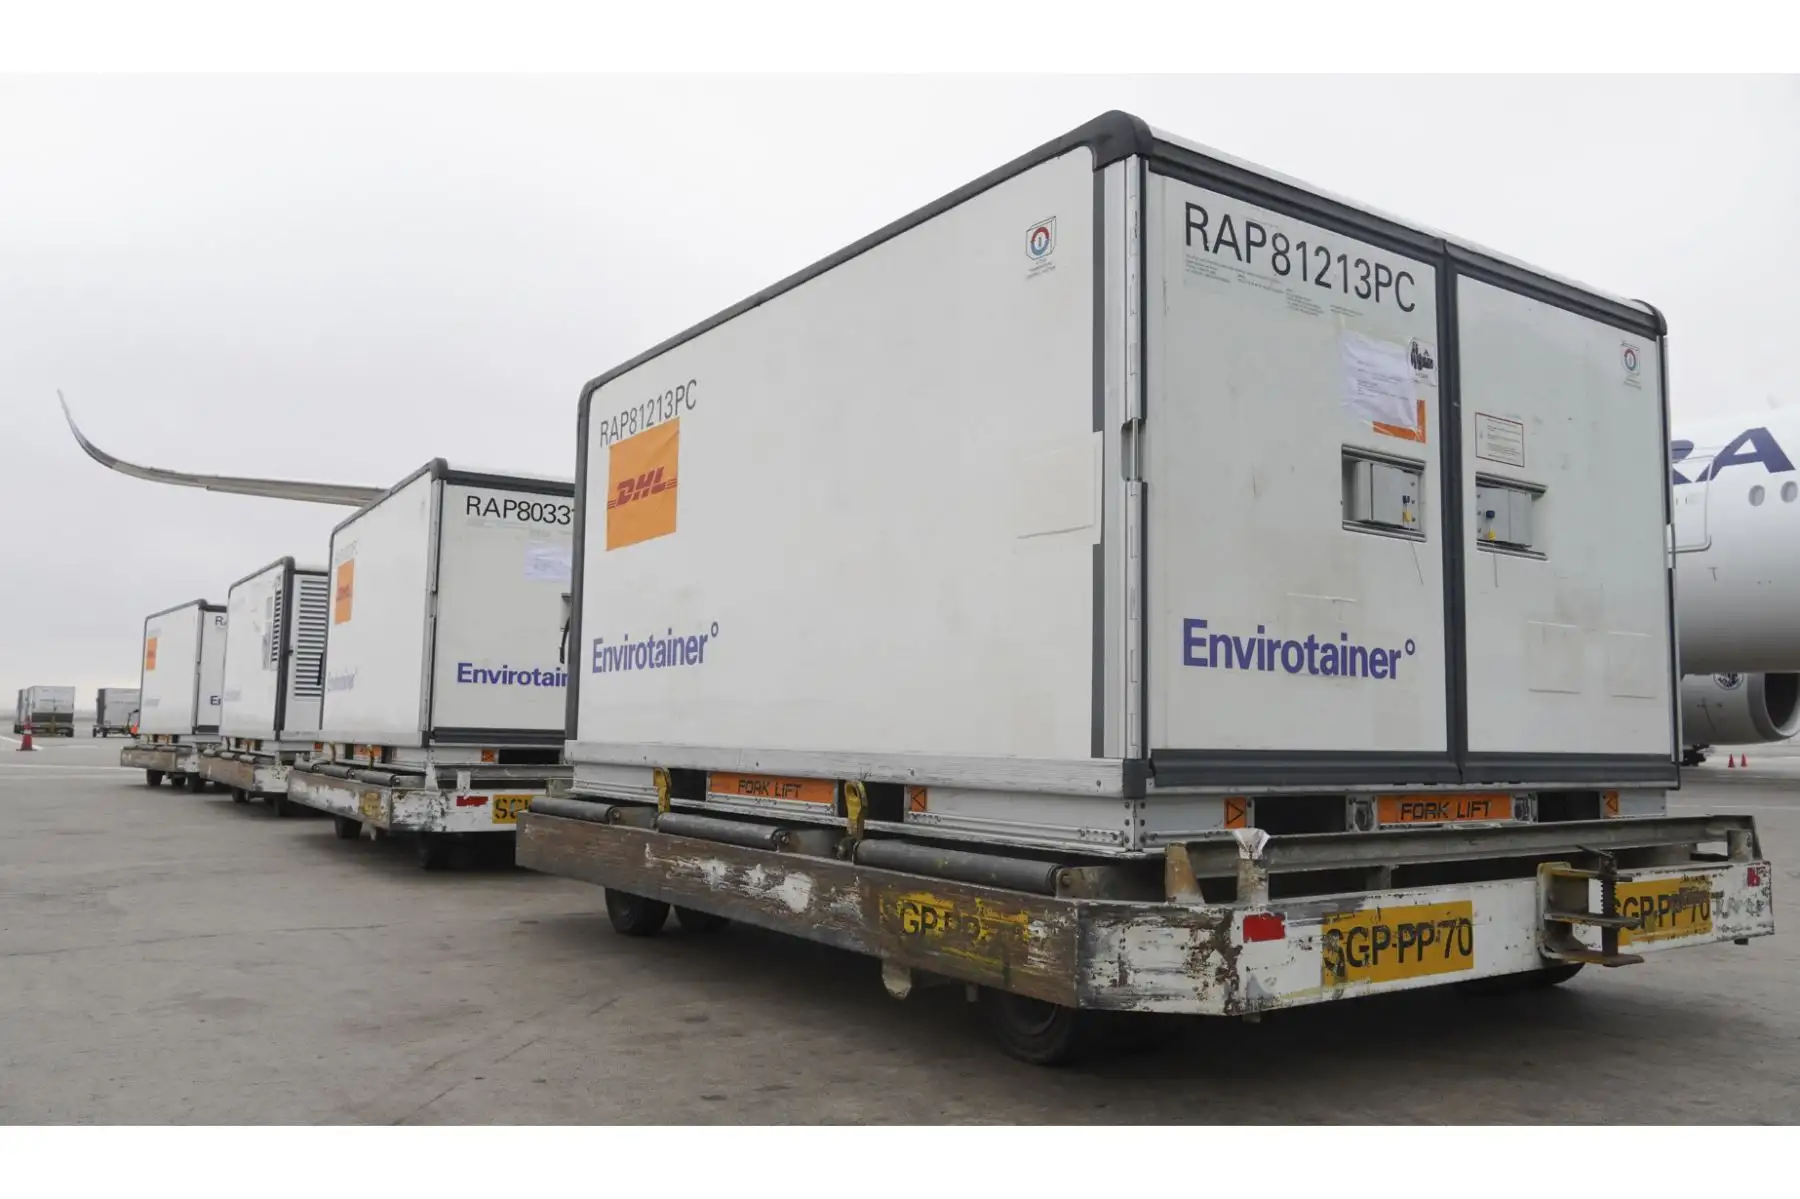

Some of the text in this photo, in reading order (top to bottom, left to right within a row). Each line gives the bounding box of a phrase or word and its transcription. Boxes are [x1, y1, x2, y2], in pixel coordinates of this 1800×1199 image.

[1184, 201, 1416, 313] RAP81213PC
[599, 378, 698, 448] RAP81213PC
[614, 466, 668, 508] DHL
[466, 495, 575, 526] RAP8033
[737, 779, 802, 799] FORK LIFT
[1400, 800, 1492, 821] FORK LIFT
